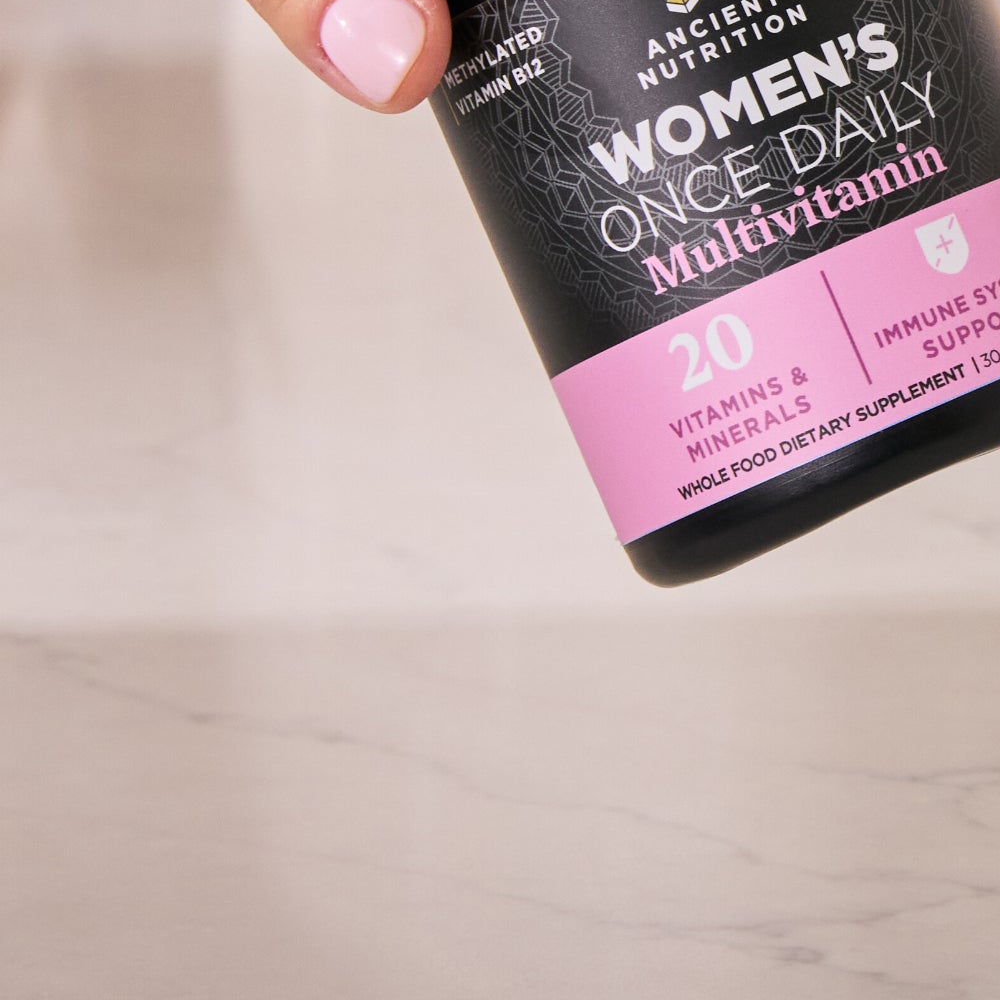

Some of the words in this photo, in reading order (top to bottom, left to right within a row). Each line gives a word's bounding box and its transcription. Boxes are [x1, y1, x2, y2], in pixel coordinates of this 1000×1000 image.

[445, 27, 543, 89] METHYLATED
[455, 75, 513, 115] VITAMIN
[512, 58, 546, 86] B12
[638, 4, 807, 90] NUTRITION
[589, 22, 899, 185] WOMEN’S
[600, 144, 771, 251] ONCE
[779, 71, 936, 174] DAILY
[641, 142, 948, 295] Multivitamin
[668, 313, 754, 392] 20
[874, 294, 970, 348] IMMUNE
[669, 376, 783, 439] VITAMINS
[791, 366, 809, 386] &
[677, 469, 731, 500] WHOLE
[730, 447, 777, 479] FOOD
[781, 412, 853, 456] DIETARY
[856, 364, 966, 422] SUPPLEMENT
[980, 350, 1000, 369] 30
[686, 395, 812, 464] MINERALS
